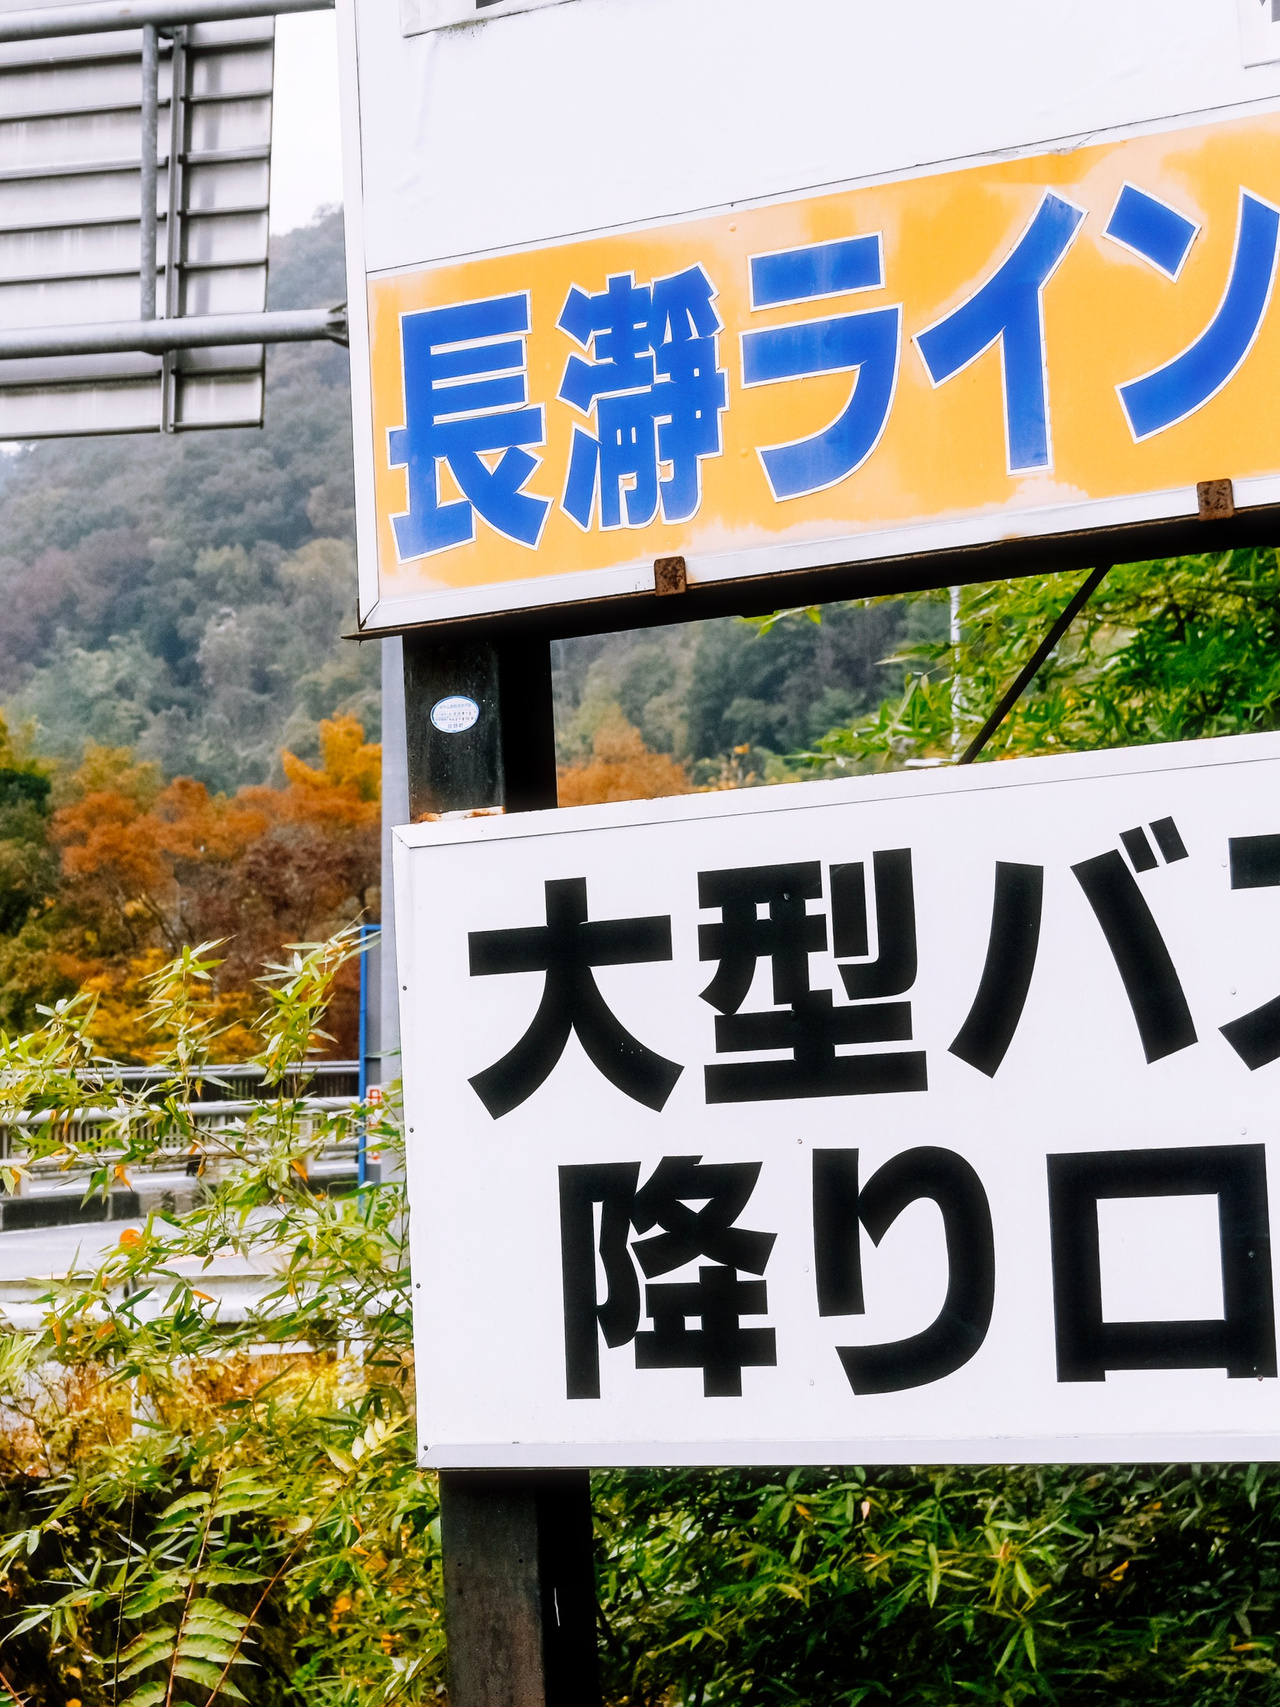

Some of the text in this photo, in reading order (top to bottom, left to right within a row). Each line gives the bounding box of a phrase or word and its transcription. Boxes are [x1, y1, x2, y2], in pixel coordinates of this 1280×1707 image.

[387, 182, 1280, 562] 長瀞ライン
[558, 1145, 1277, 1399] 降り口
